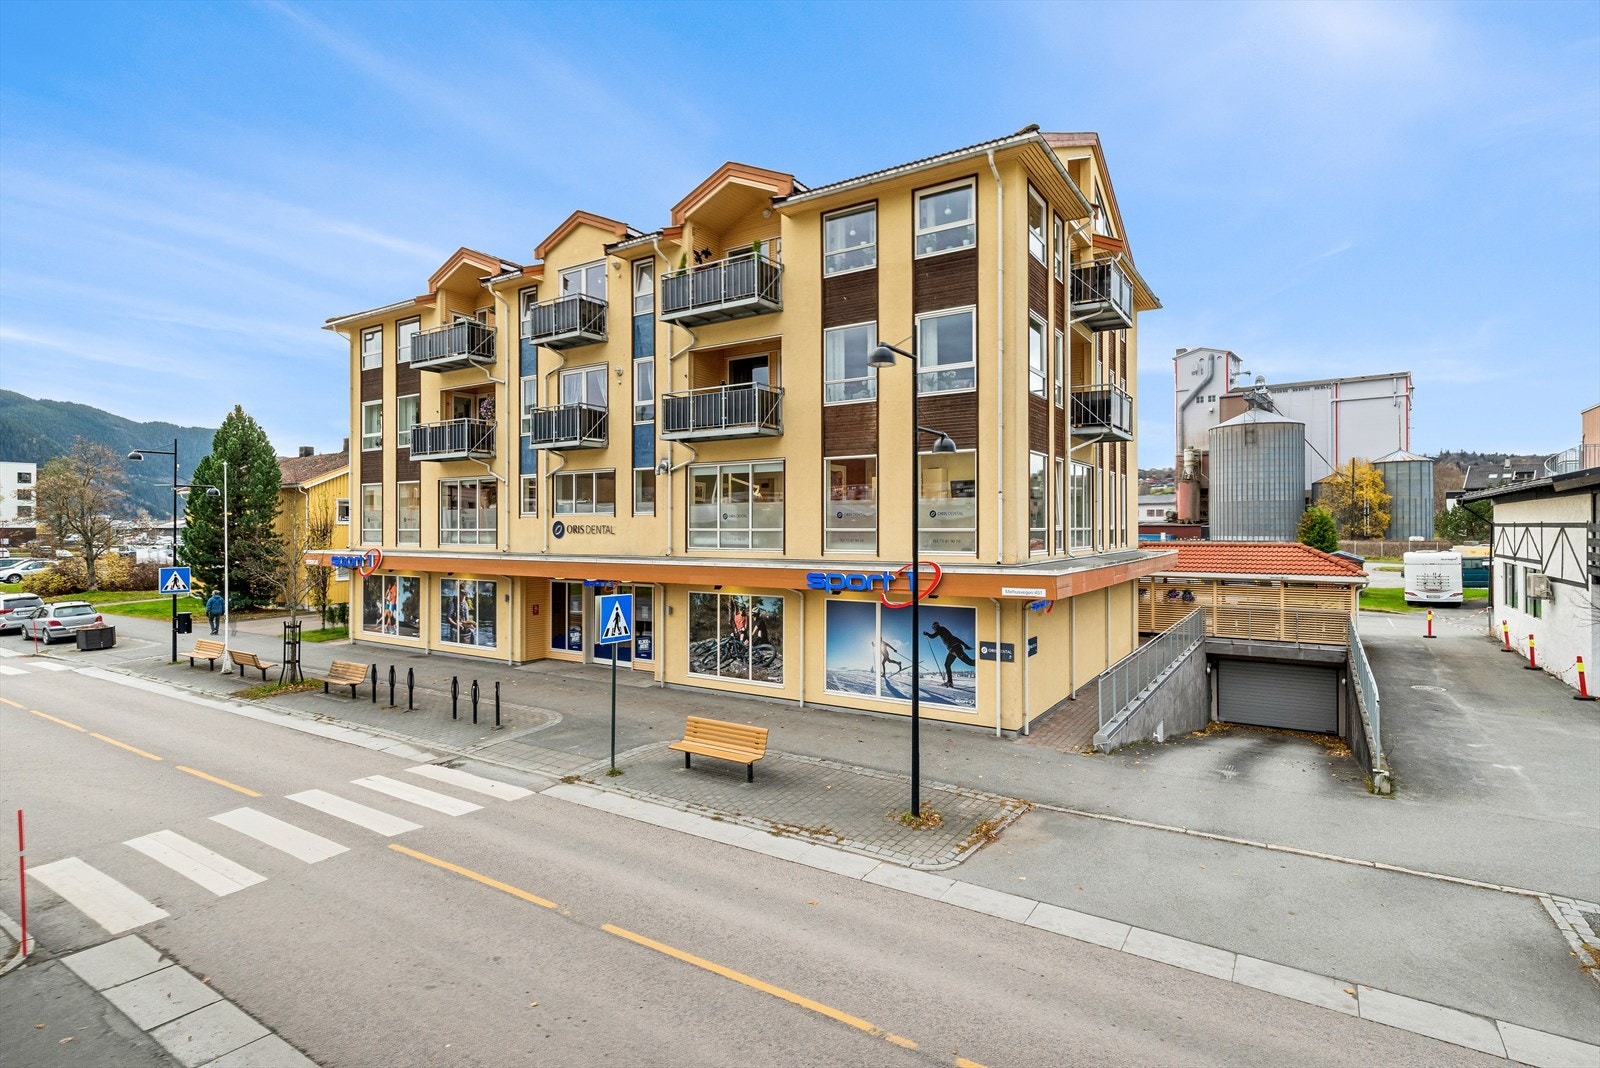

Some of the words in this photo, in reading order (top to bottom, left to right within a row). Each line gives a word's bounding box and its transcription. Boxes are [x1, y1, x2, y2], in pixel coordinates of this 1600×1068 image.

[566, 525, 585, 534] ORIS
[585, 525, 616, 535] DENTAL
[807, 571, 896, 593] sport
